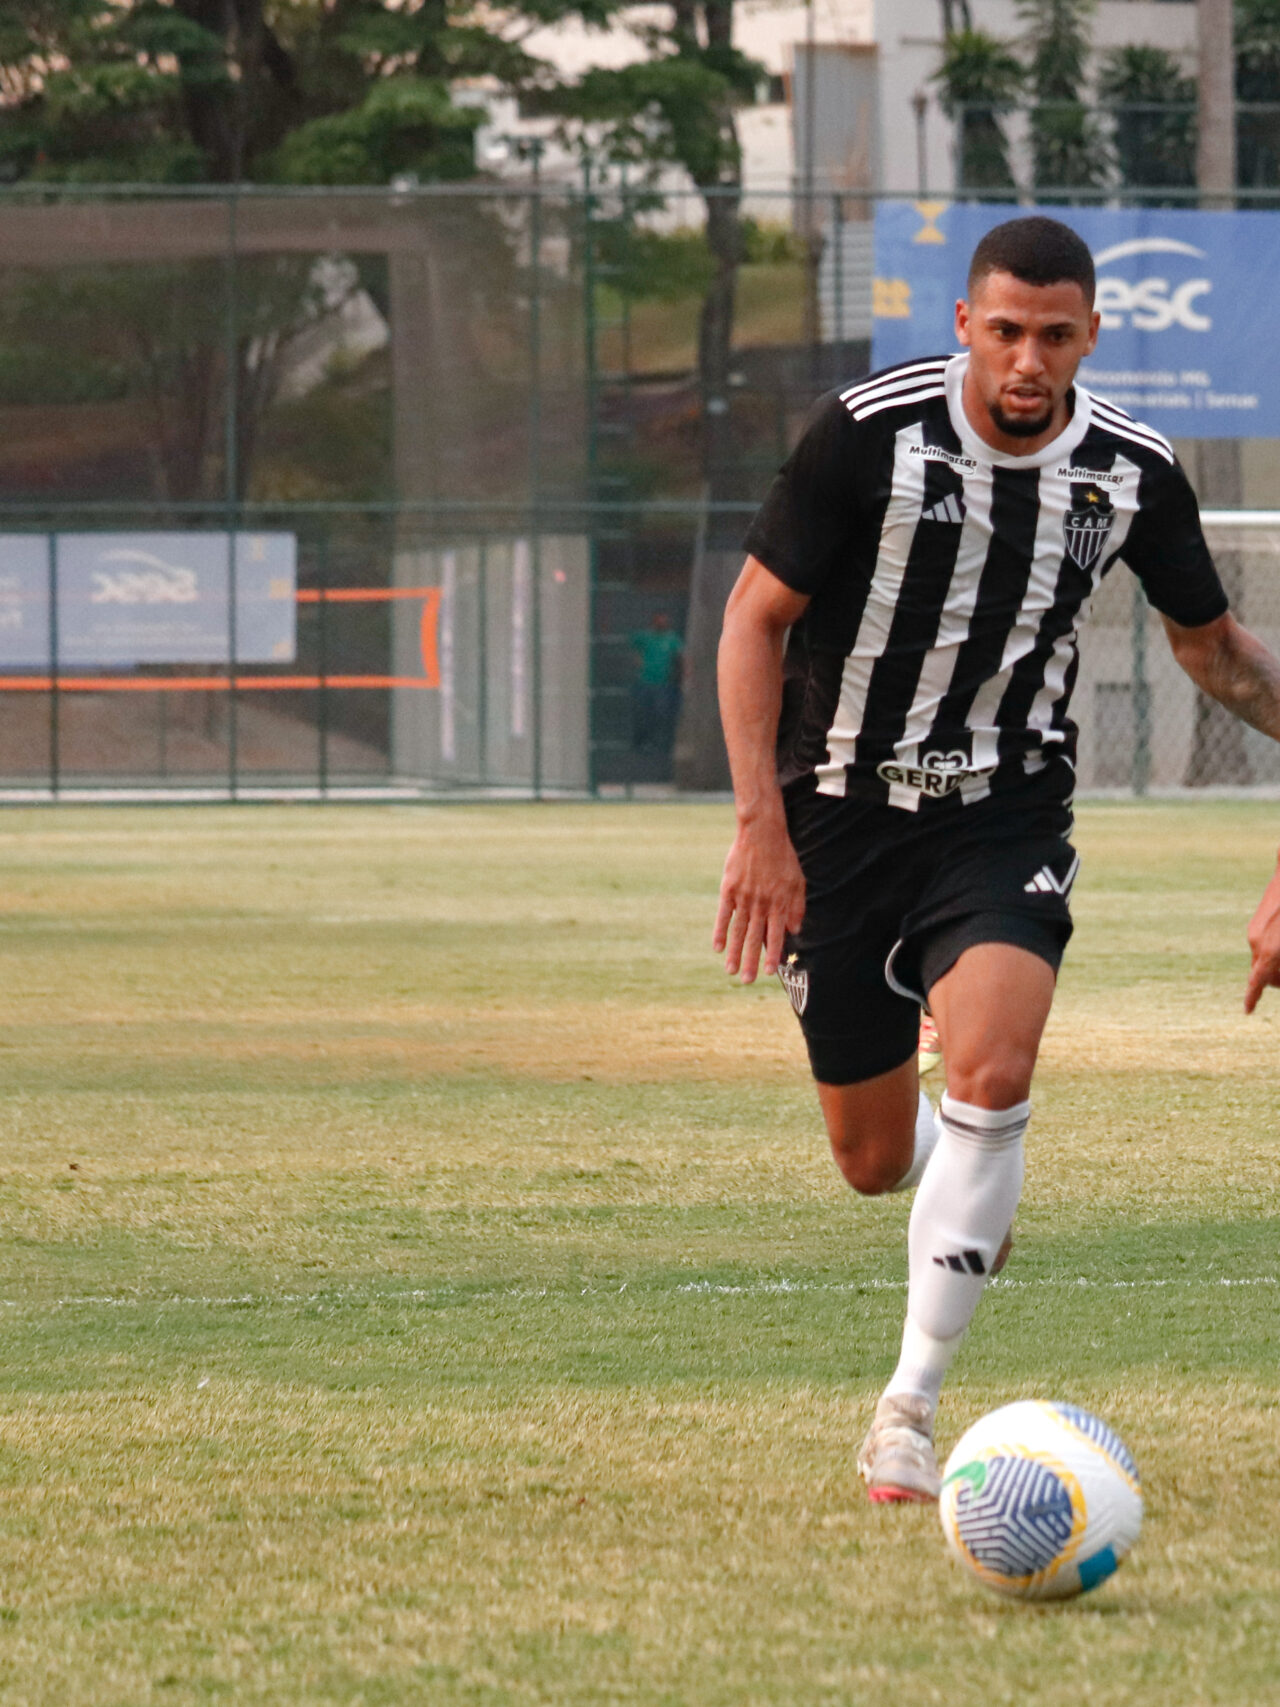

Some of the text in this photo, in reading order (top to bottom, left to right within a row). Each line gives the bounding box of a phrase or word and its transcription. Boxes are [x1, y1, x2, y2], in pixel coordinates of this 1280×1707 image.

[1094, 276, 1212, 332] esc
[909, 445, 977, 467] Multimarcas
[1057, 468, 1124, 483] Multimarcas
[1071, 517, 1108, 529] CAM
